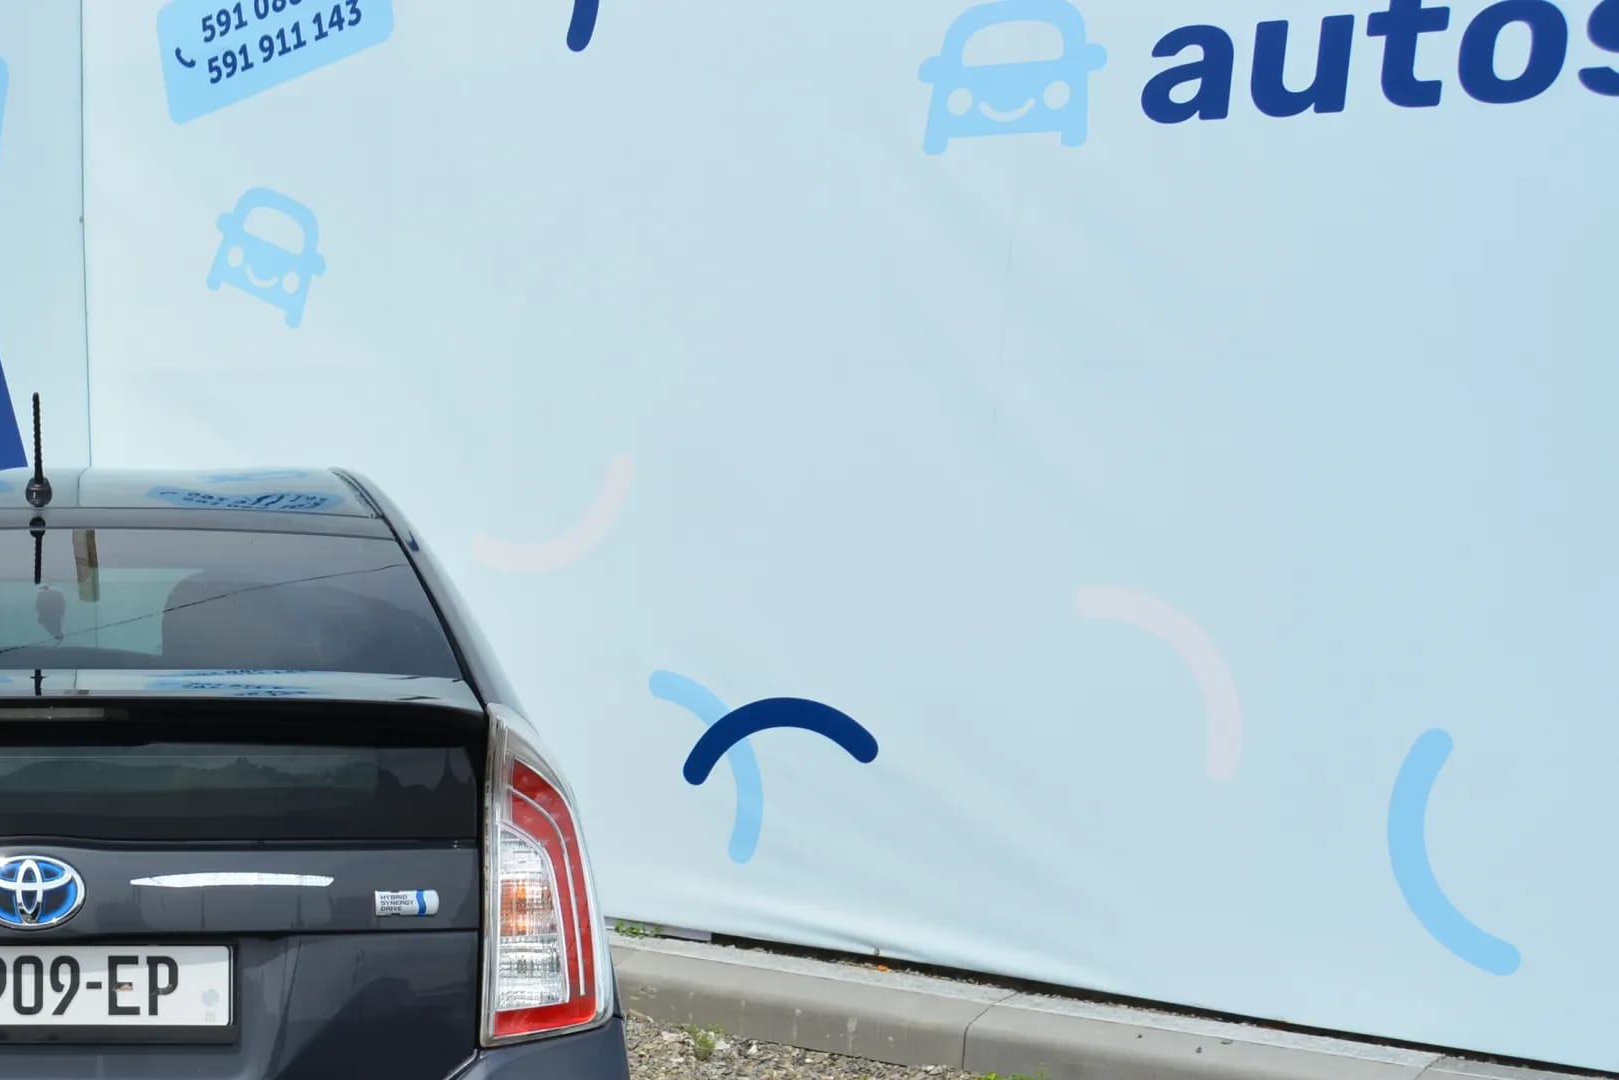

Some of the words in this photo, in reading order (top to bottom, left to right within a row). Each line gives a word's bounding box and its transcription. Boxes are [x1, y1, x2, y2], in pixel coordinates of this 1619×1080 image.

[200, 2, 248, 43] 591
[207, 43, 255, 85] 591
[258, 21, 307, 64] 911
[312, 0, 362, 42] 143
